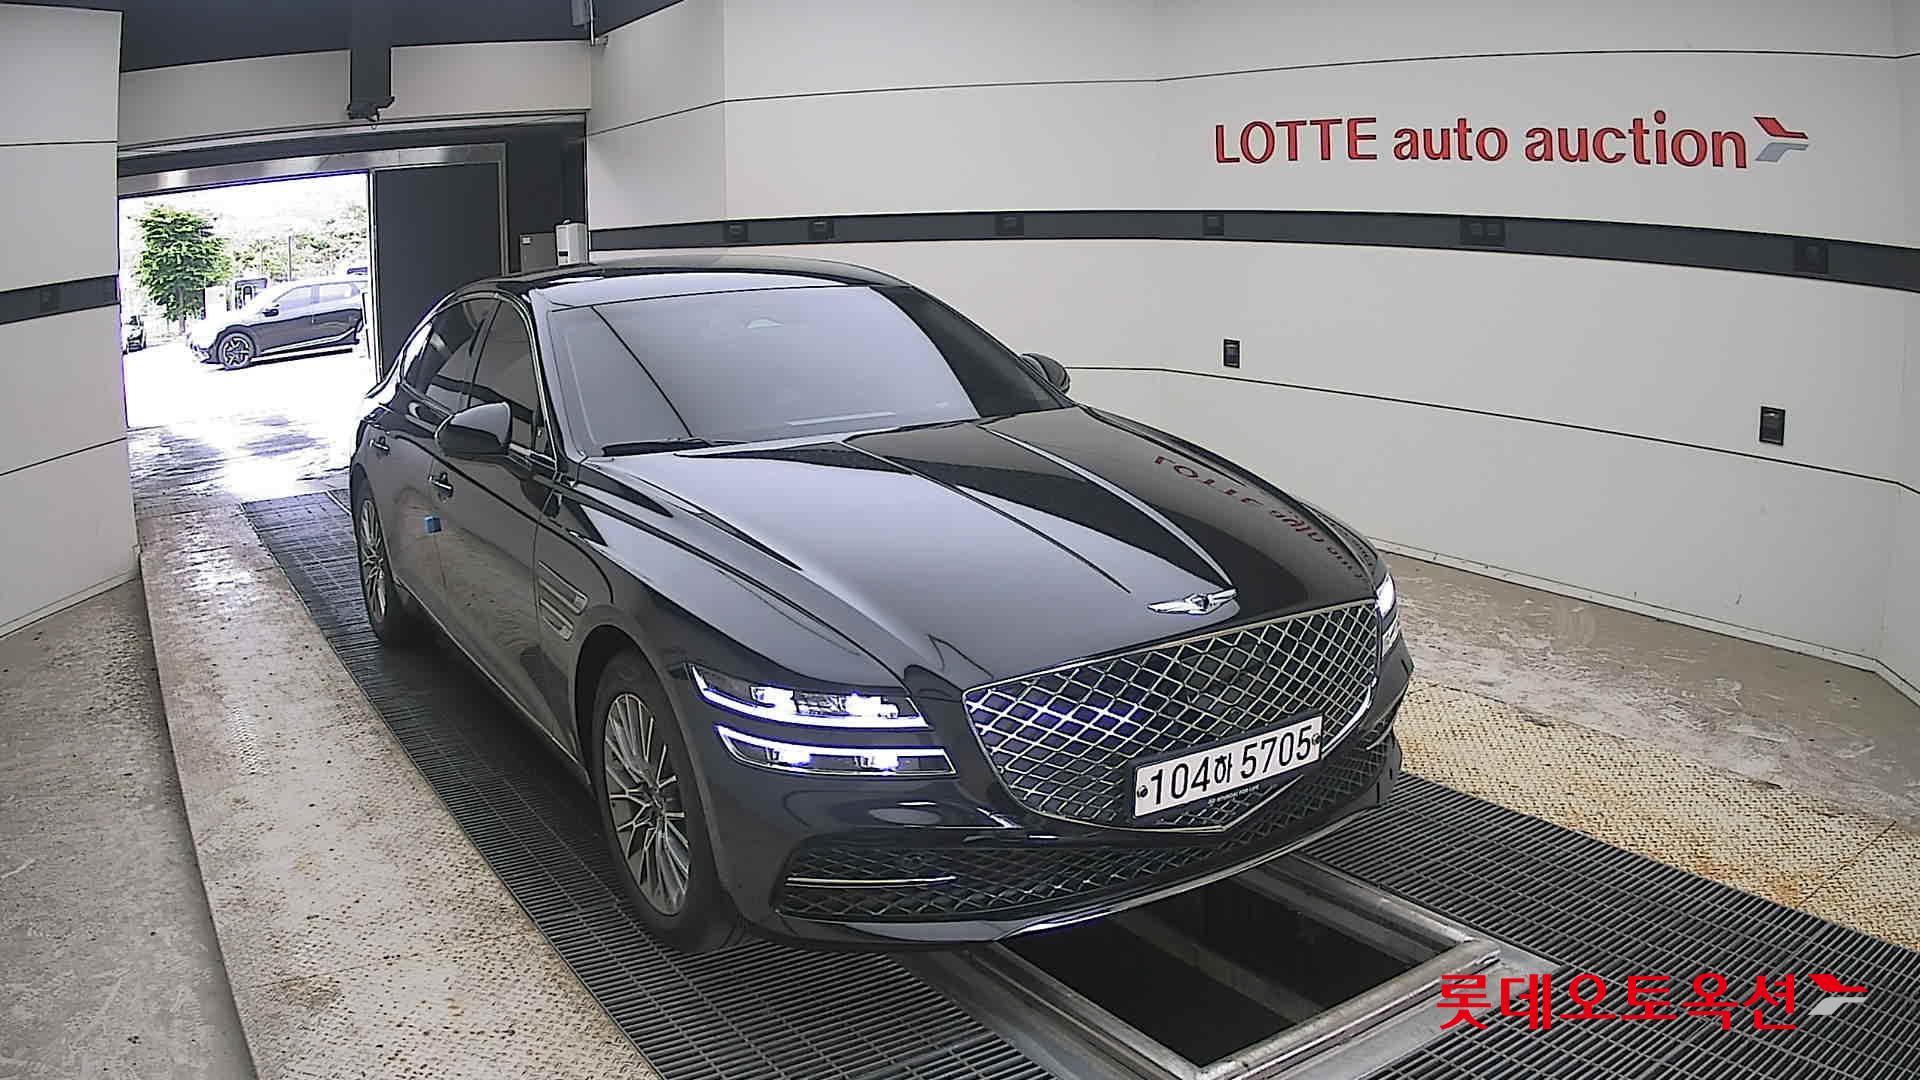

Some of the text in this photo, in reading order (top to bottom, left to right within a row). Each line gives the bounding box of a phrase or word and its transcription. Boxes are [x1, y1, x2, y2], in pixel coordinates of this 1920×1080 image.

[1215, 110, 1747, 168] LOTTE auto auction
[1149, 752, 1233, 805] 104하
[1239, 724, 1313, 779] 5705
